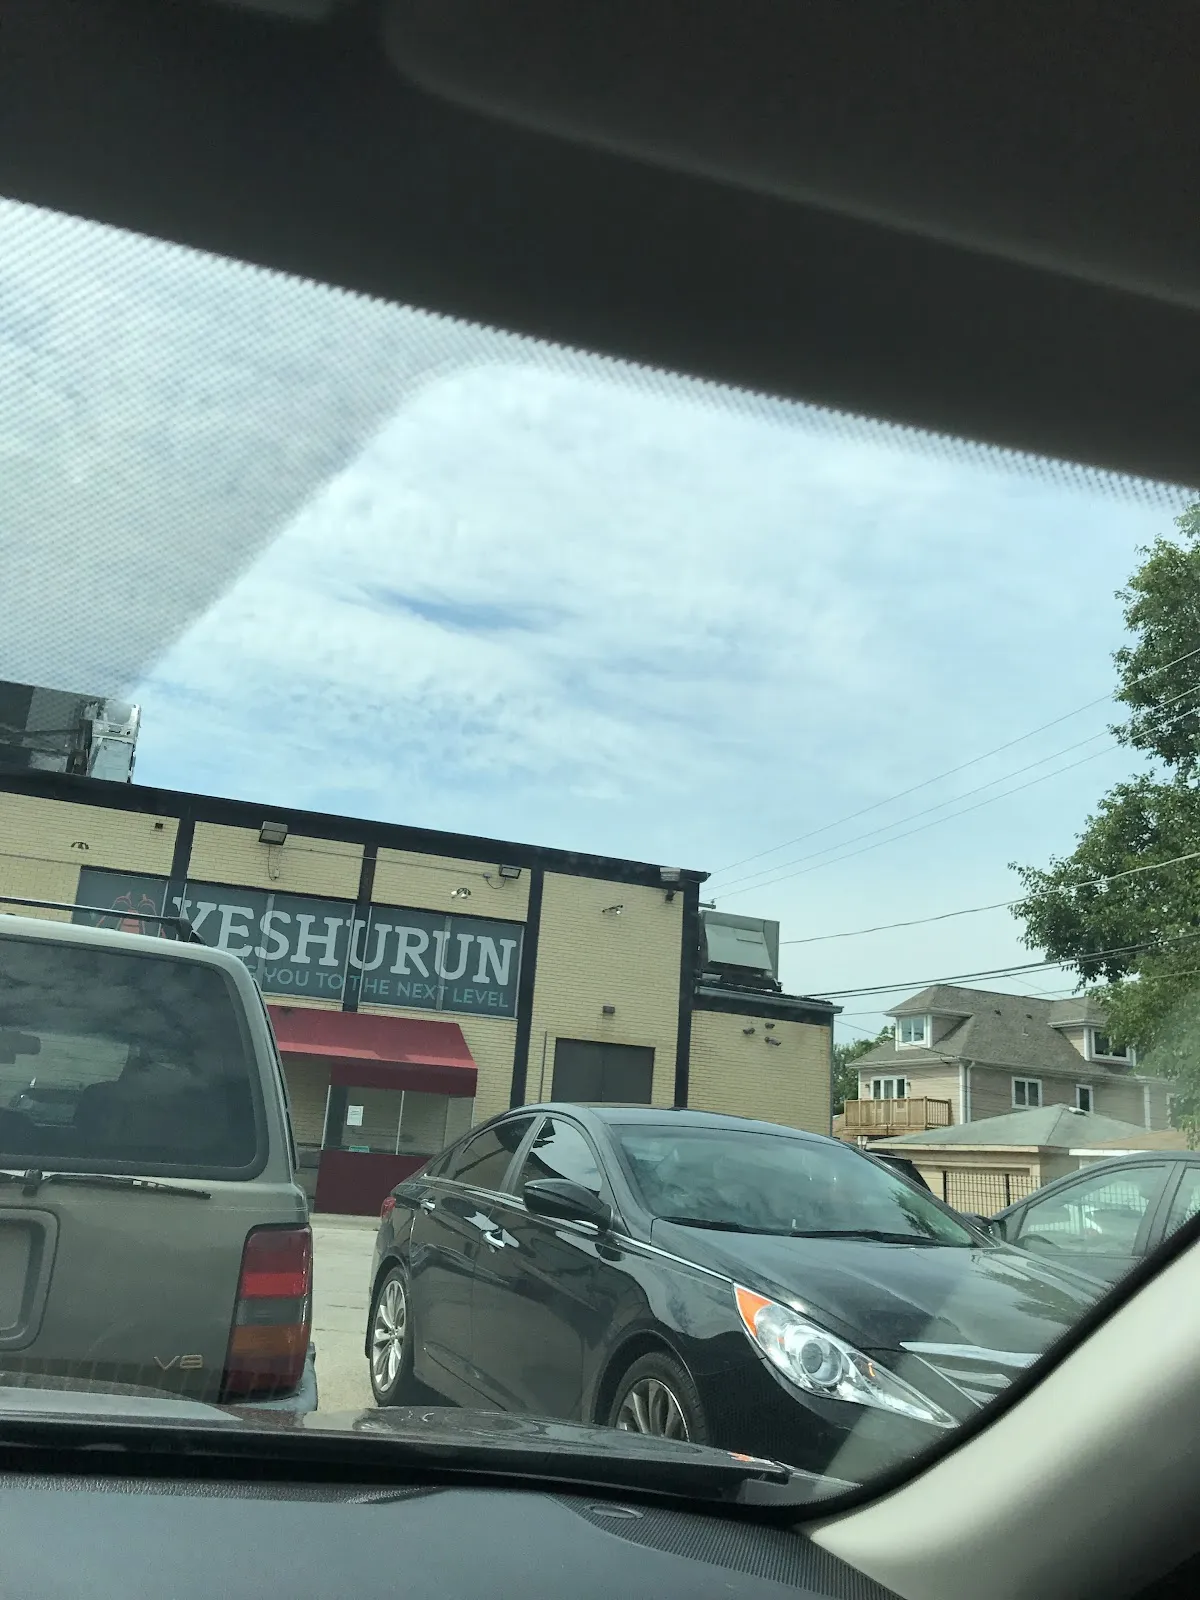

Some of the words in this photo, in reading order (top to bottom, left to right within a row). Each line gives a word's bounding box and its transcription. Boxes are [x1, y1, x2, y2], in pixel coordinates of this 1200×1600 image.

[172, 896, 517, 986] YESHURUN
[264, 968, 309, 987] YOU
[315, 972, 344, 989] TO
[349, 975, 390, 995] THE
[396, 981, 448, 1001] NEXT
[453, 988, 508, 1008] LEVEL
[153, 1354, 203, 1370] V8
